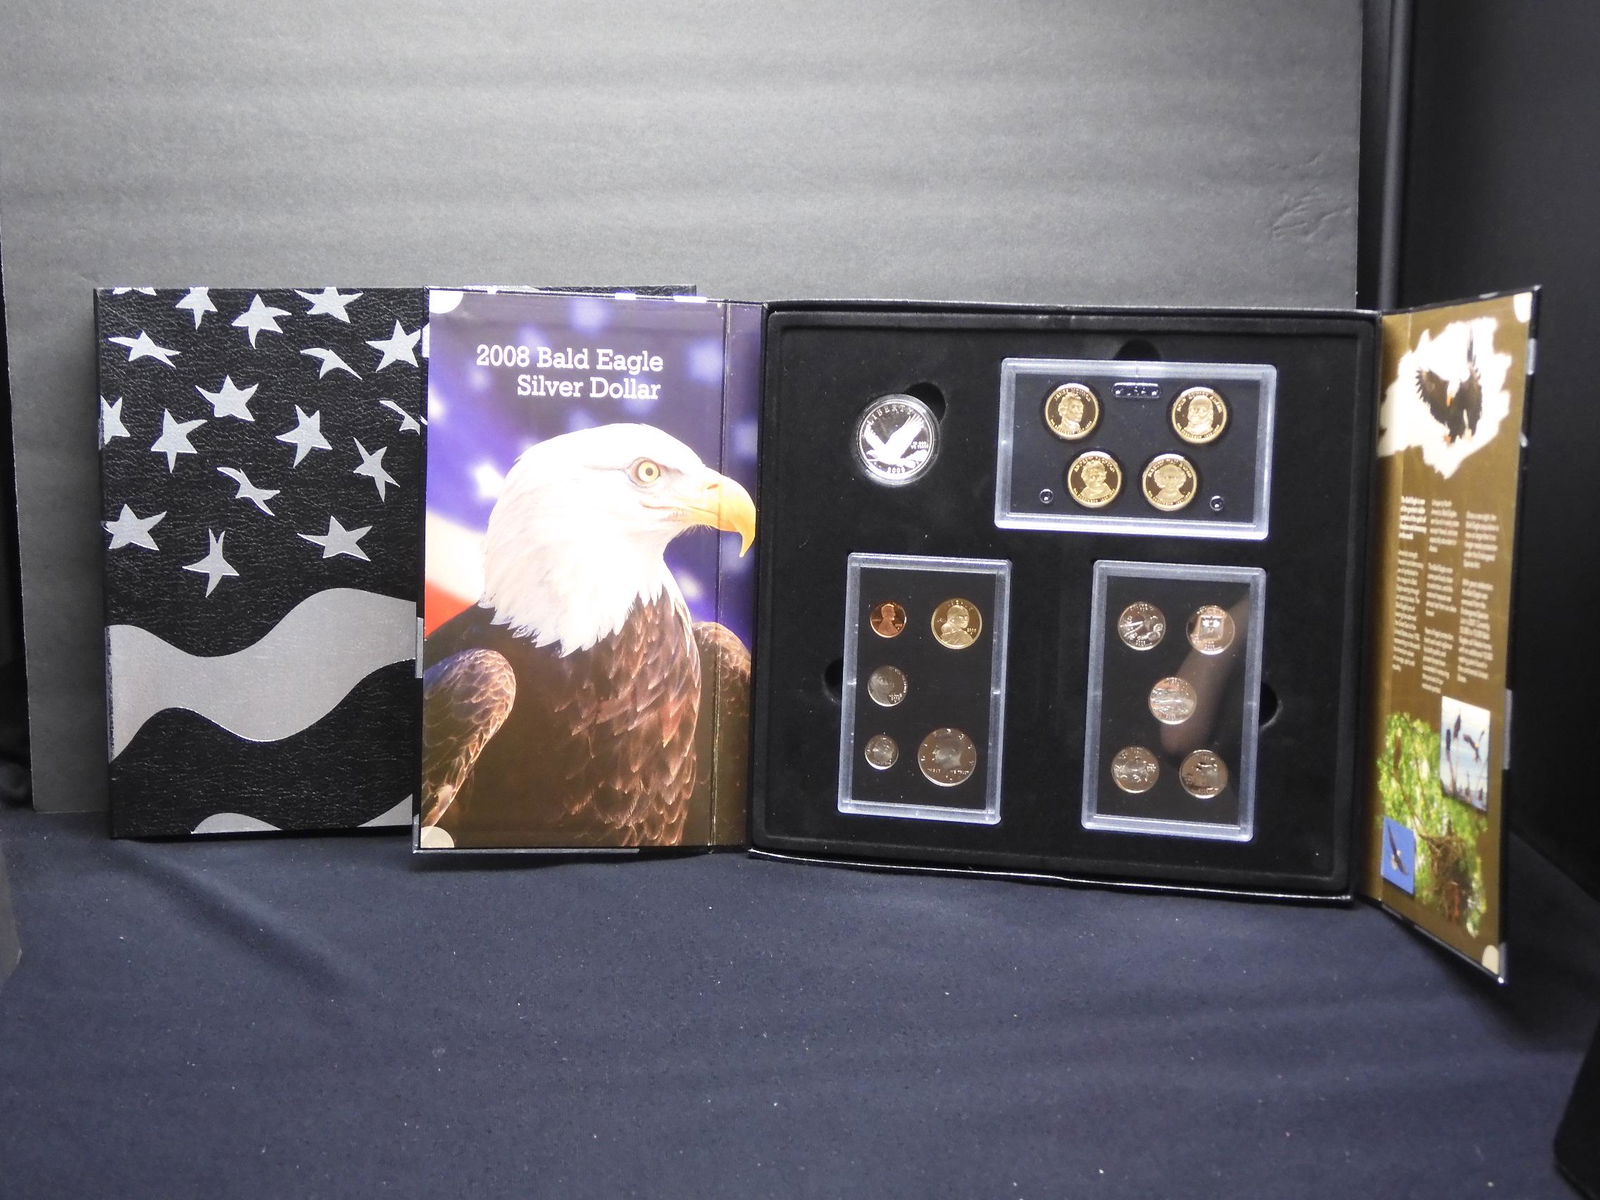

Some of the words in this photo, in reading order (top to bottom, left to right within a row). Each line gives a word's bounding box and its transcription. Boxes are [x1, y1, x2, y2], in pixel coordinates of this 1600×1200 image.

[476, 344, 530, 368] 2008
[536, 346, 590, 370] Bald
[596, 348, 664, 375] Eagle
[517, 374, 584, 397] Silver
[589, 377, 661, 400] Dollar
